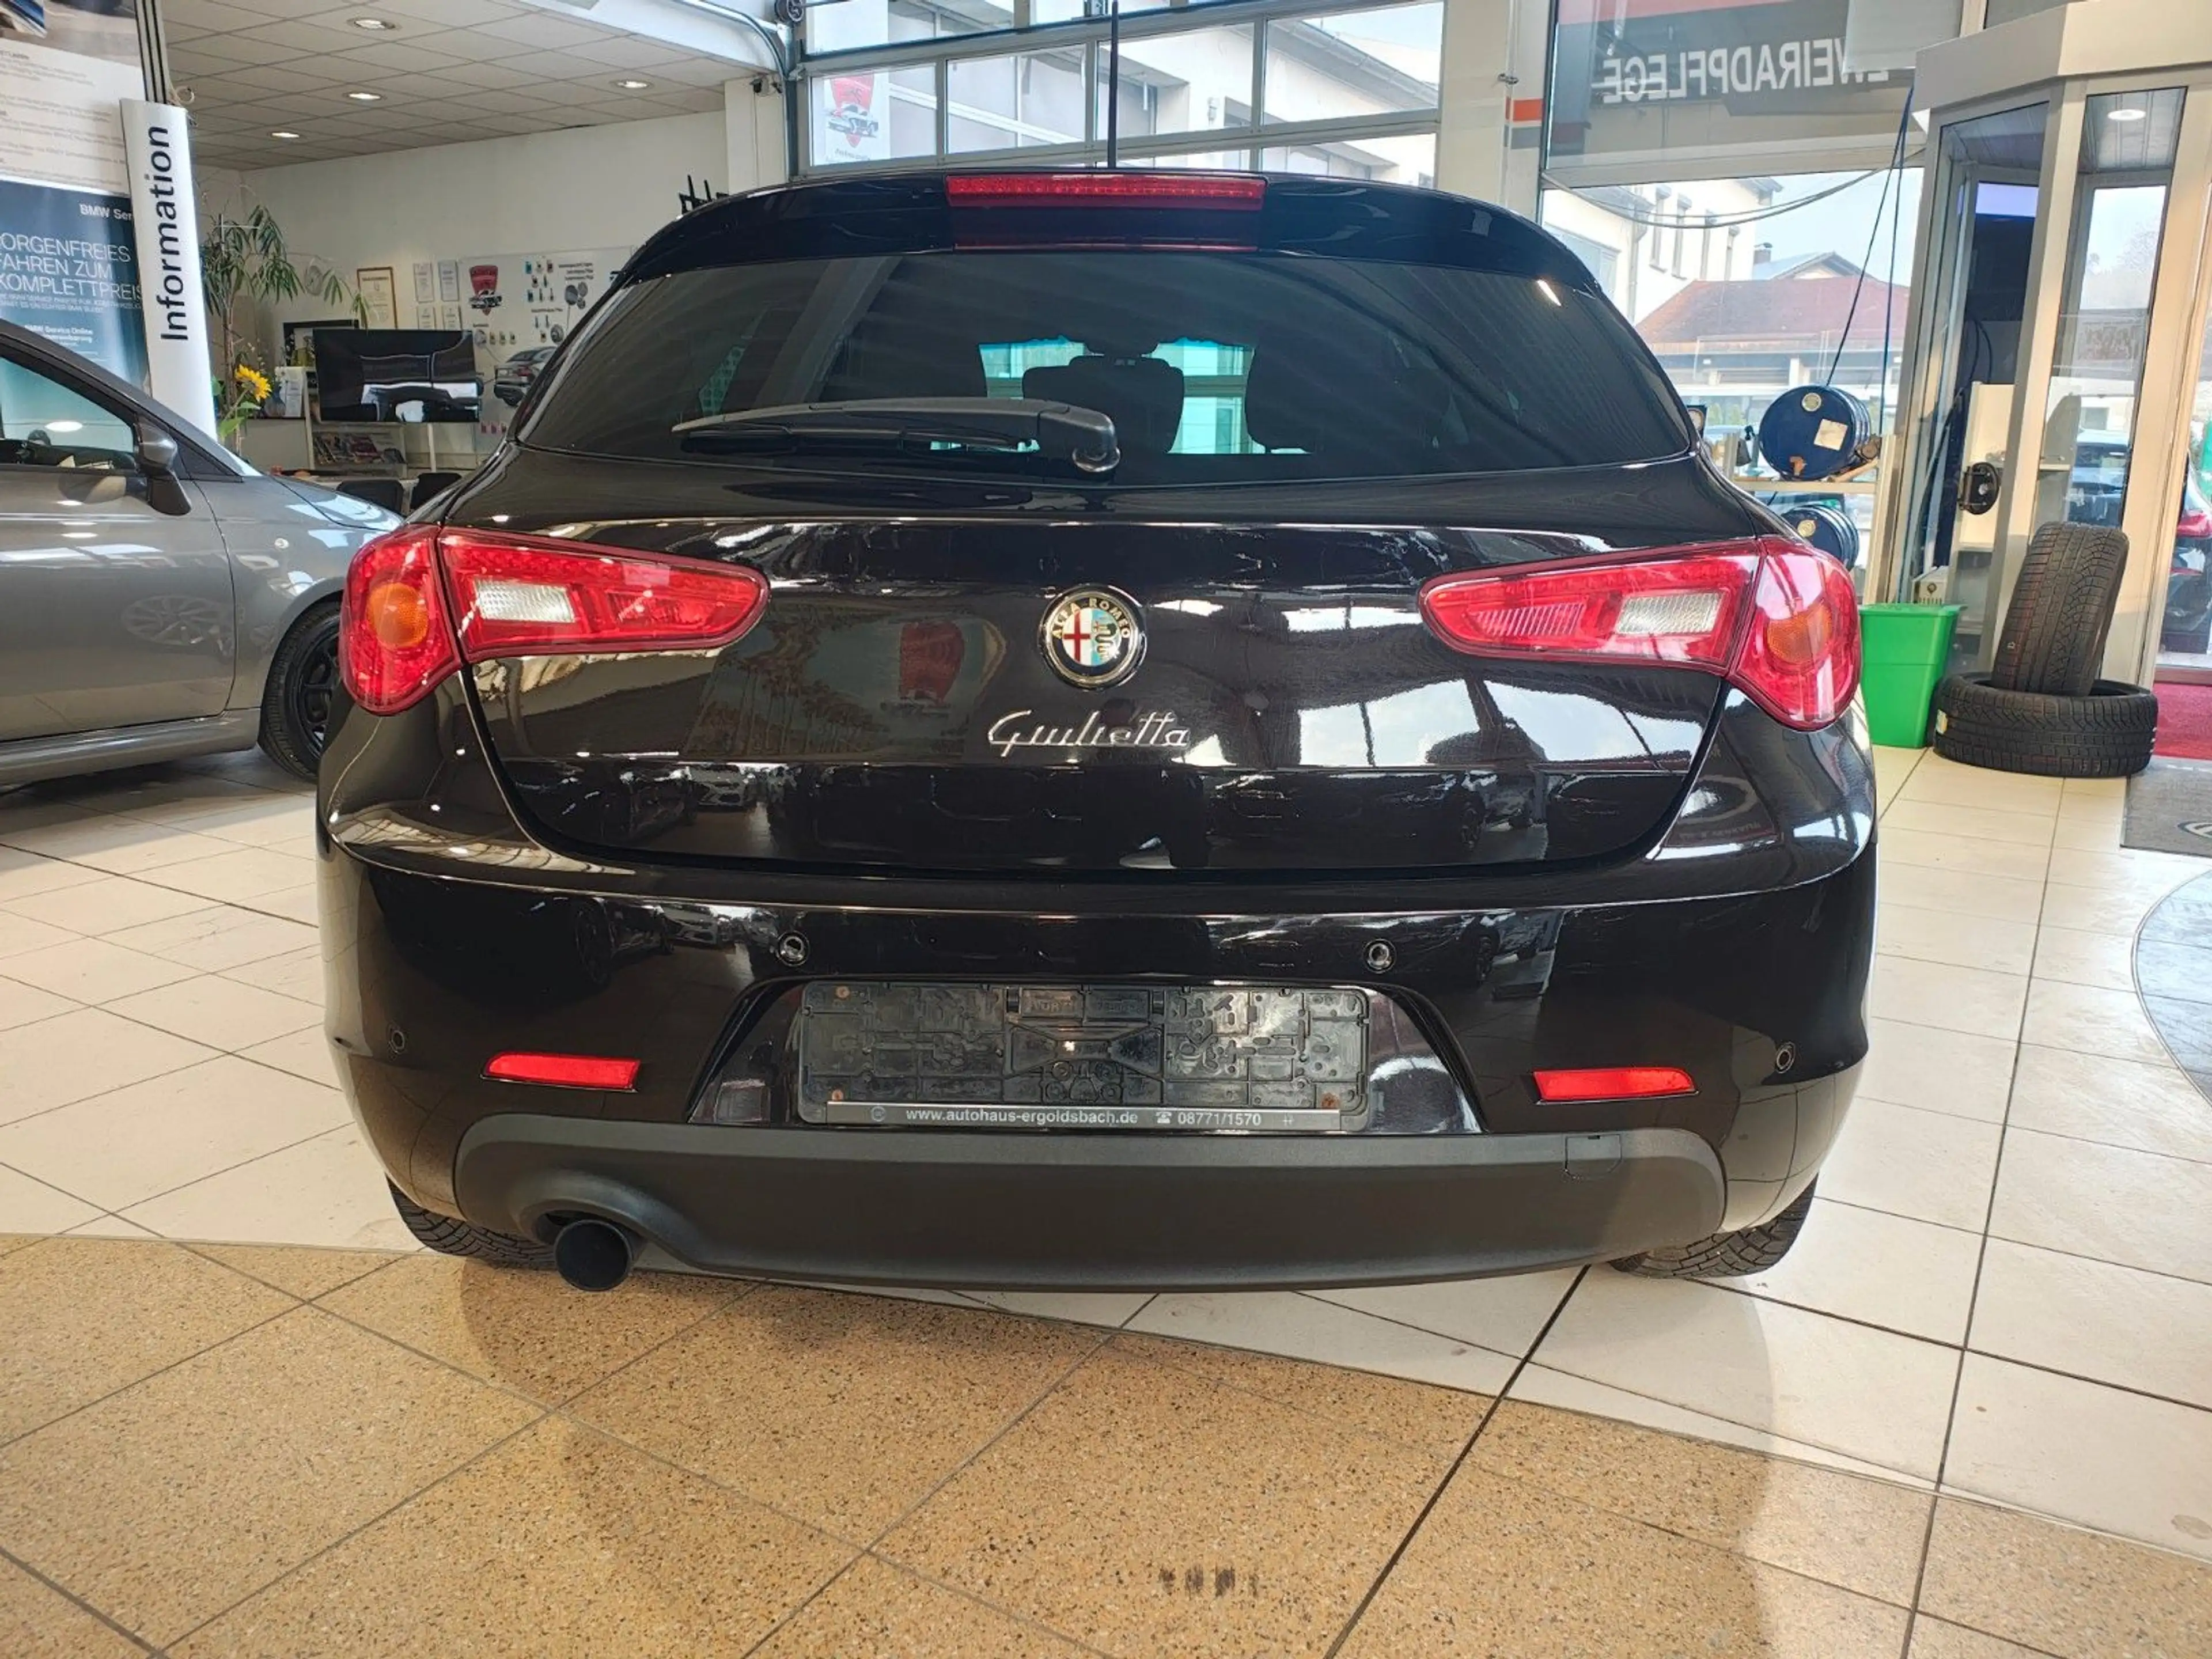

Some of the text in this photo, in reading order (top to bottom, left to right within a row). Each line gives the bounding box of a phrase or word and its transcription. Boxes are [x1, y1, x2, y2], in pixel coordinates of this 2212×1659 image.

[79, 204, 109, 218] BMW
[0, 232, 131, 262] ORGENFREIES
[145, 125, 189, 341] Information
[0, 252, 113, 279] AHREN ZUM
[1052, 597, 1131, 639] ALFA ROMEO
[988, 709, 1190, 757] Giulietta
[906, 1108, 1262, 1126] www.autohaus-ergoldsbach.de 08771/1570
